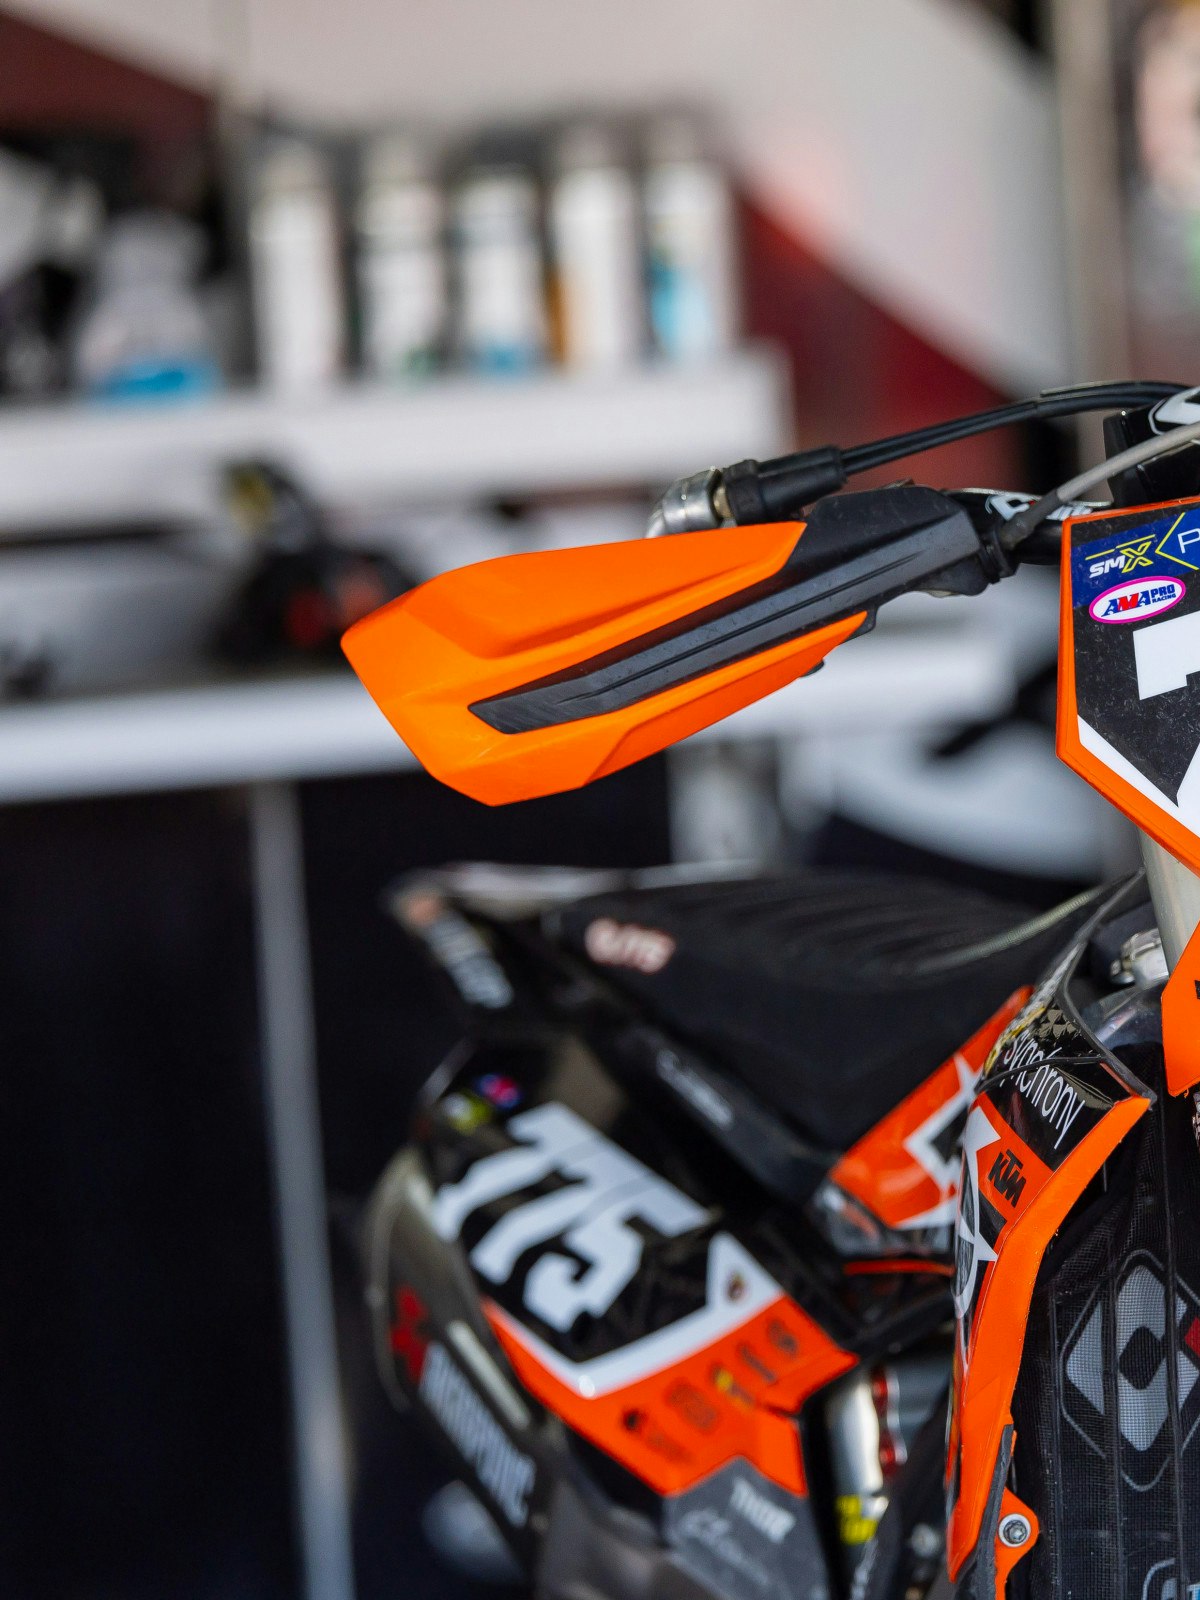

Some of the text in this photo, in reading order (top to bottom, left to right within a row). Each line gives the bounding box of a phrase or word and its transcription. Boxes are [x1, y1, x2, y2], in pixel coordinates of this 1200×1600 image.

[1088, 541, 1154, 579] SMX
[1100, 583, 1176, 618] AMA PRO
[1151, 592, 1177, 604] RACING
[987, 1148, 1027, 1209] KTM
